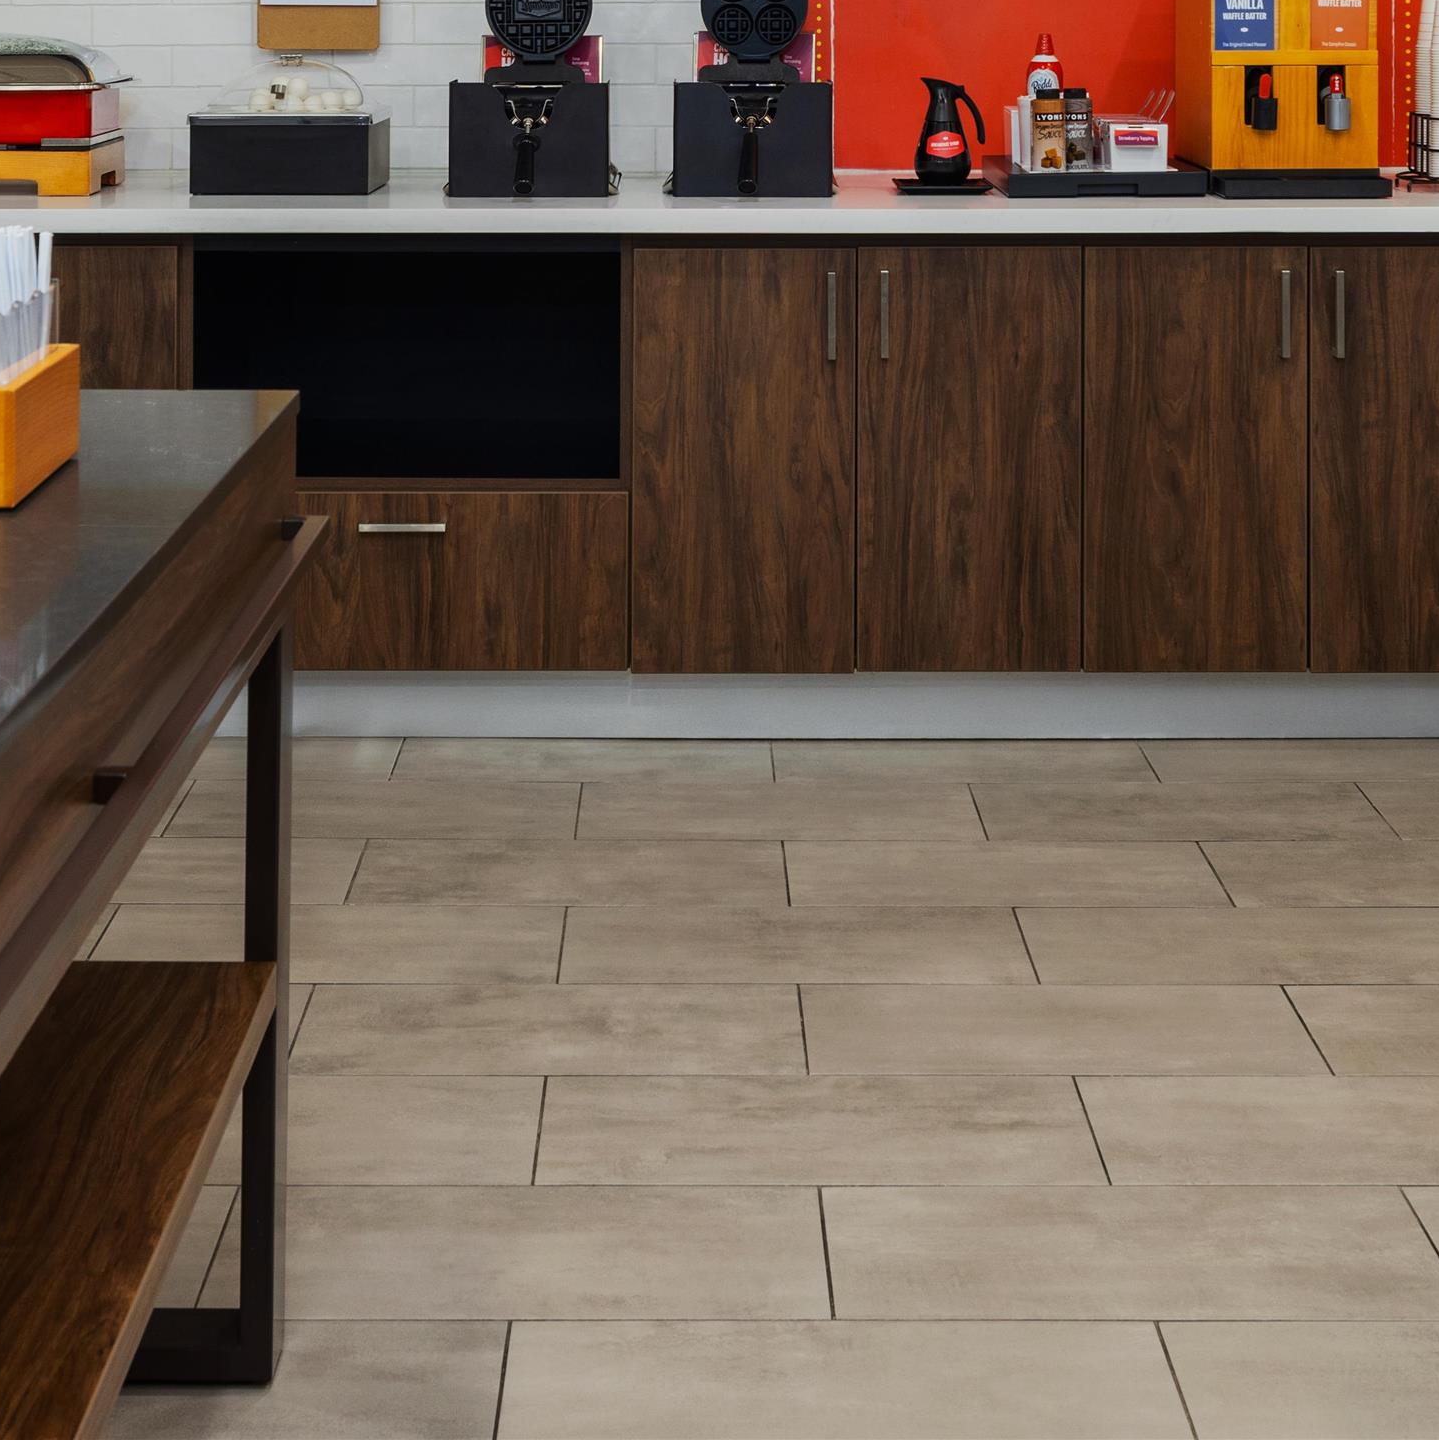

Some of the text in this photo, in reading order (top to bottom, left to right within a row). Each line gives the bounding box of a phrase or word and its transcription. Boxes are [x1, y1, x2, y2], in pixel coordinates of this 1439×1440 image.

[1318, 0, 1362, 7] WAFFLE BATTER
[1222, 12, 1267, 20] WAFFLE BATTER
